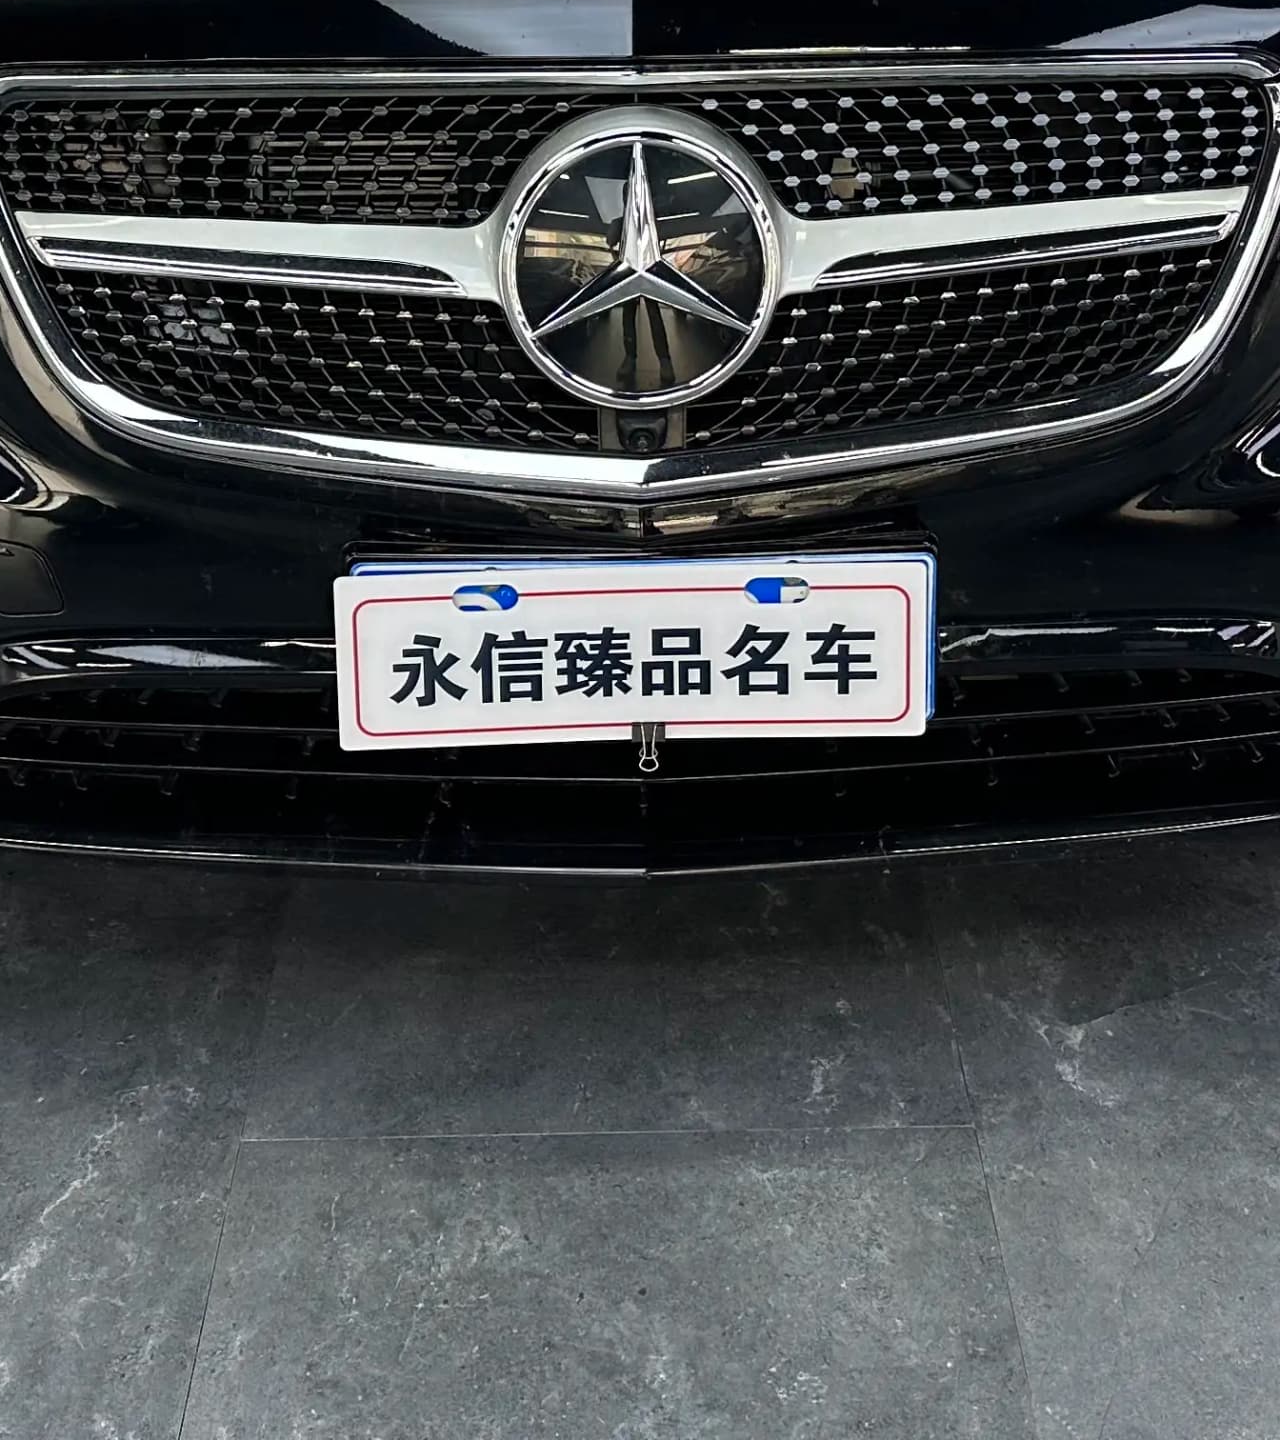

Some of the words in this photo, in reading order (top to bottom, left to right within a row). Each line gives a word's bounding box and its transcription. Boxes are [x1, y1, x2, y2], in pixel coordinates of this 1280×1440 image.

[389, 623, 878, 707] 永信臻品名车
